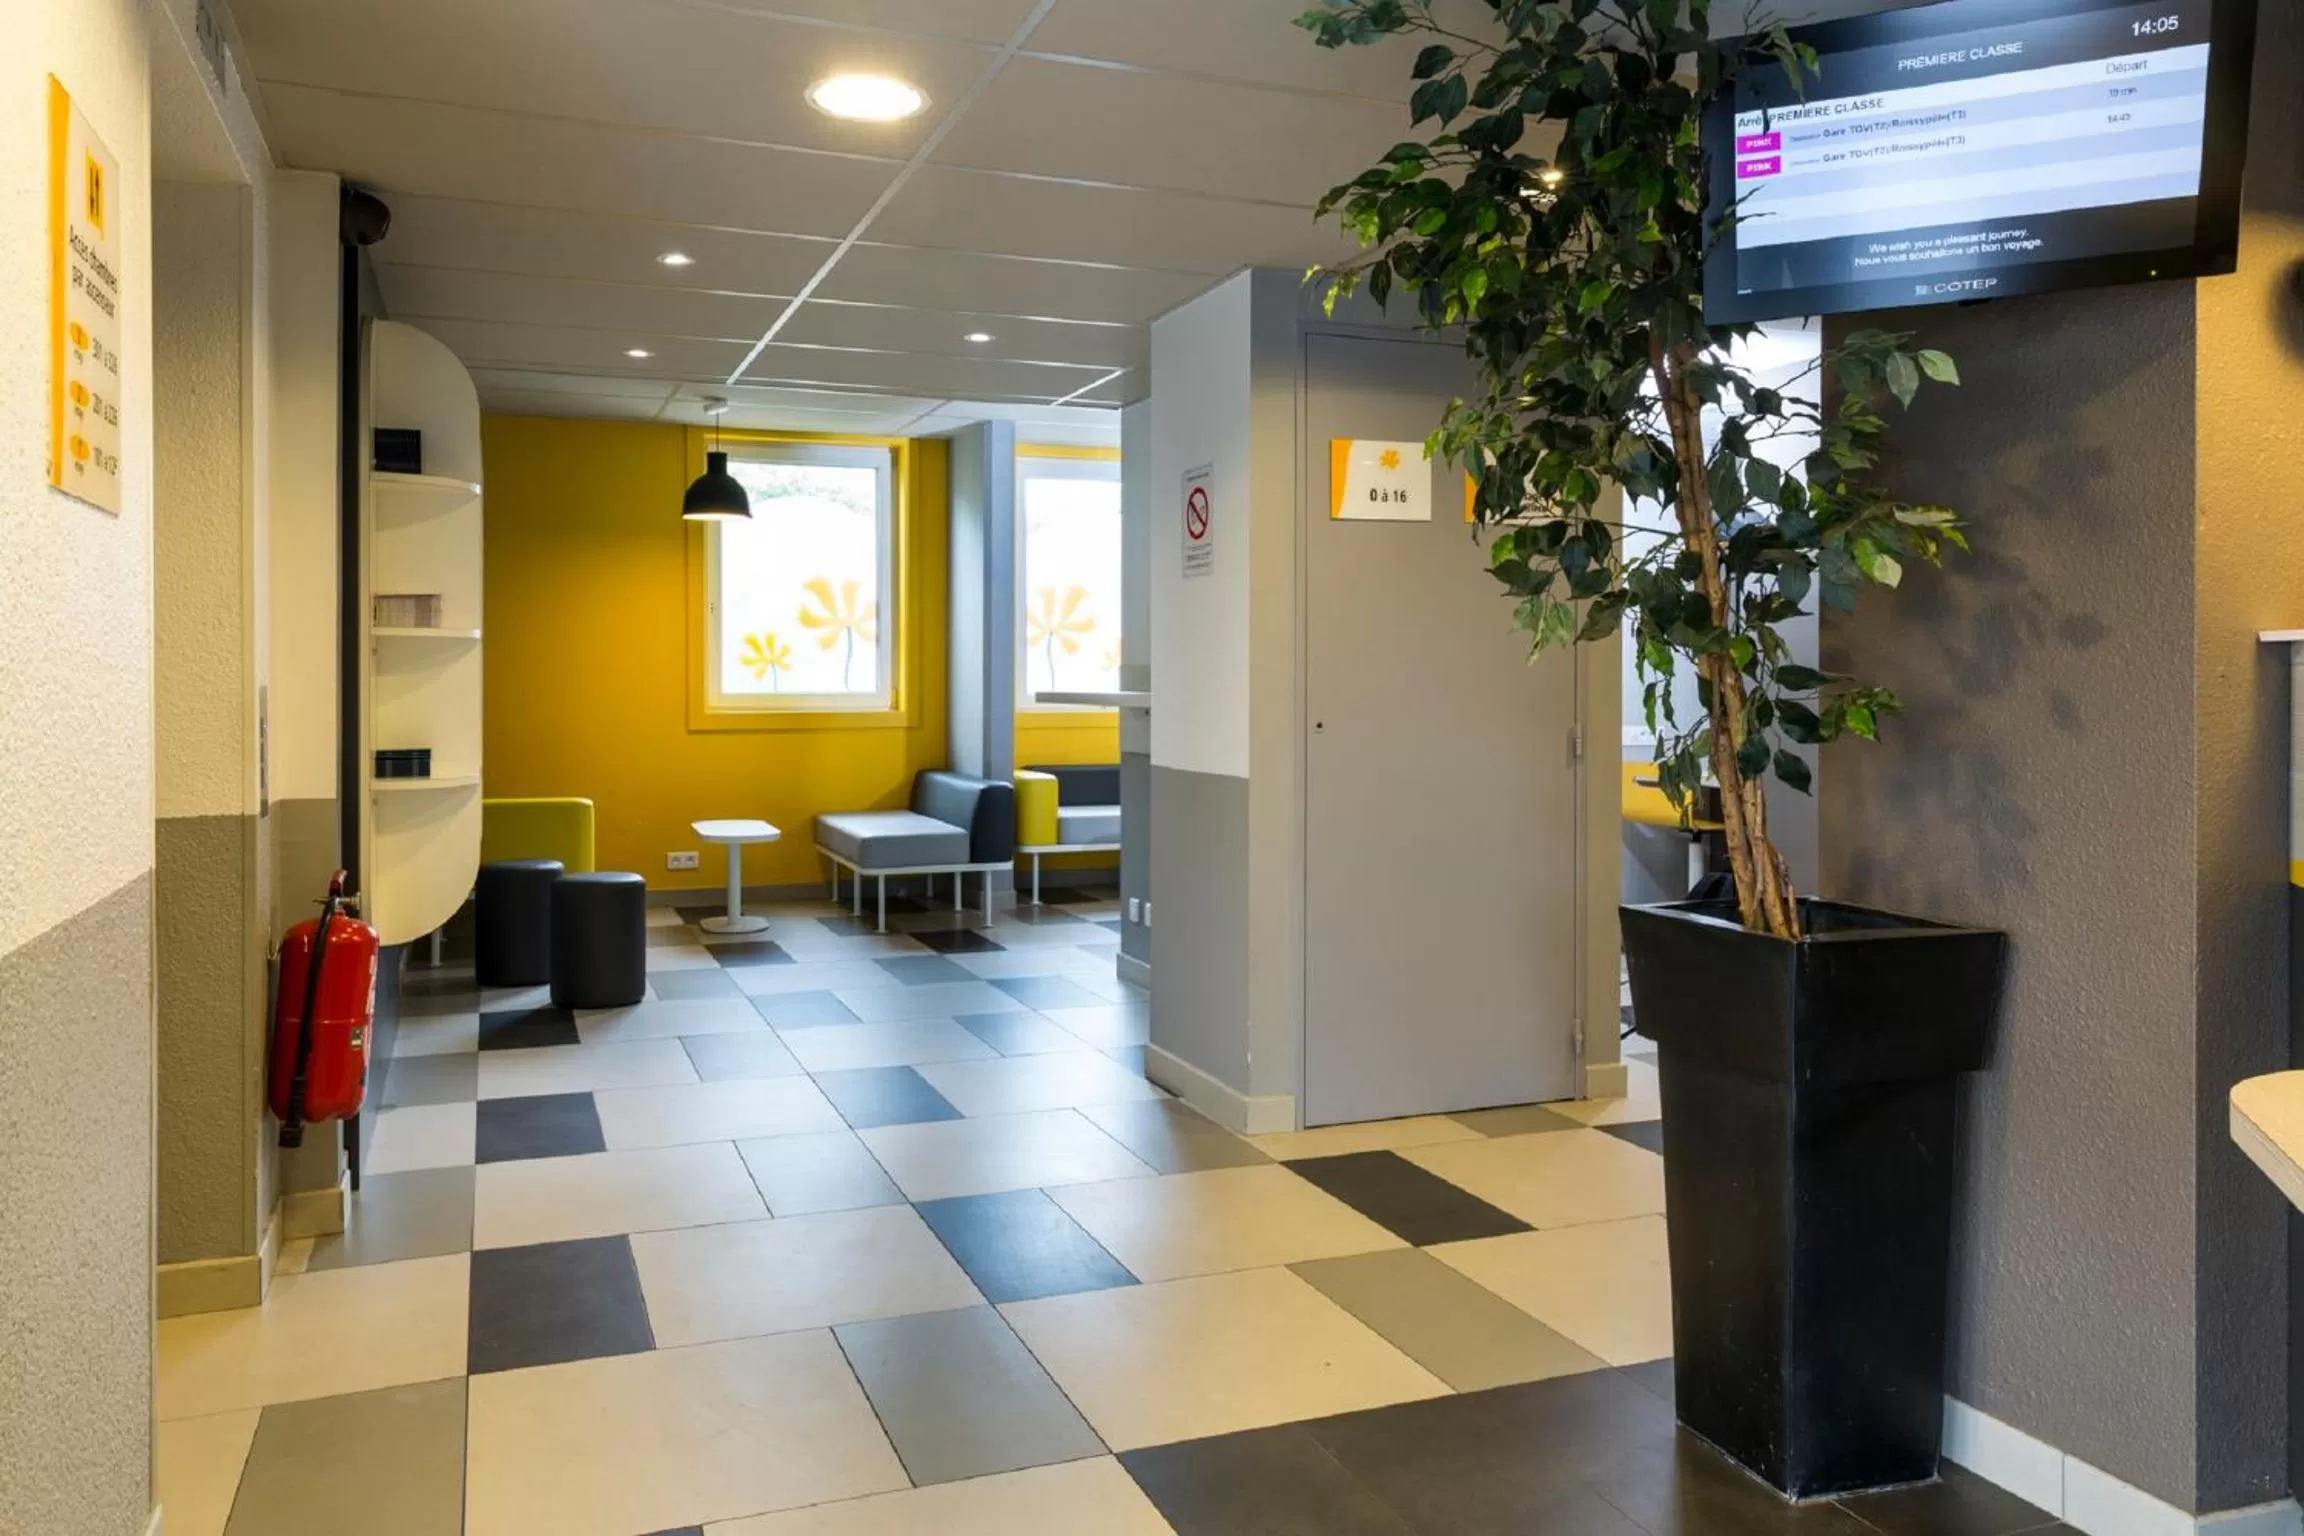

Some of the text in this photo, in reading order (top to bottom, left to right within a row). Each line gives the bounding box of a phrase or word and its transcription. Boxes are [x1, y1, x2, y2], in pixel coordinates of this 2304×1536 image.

[2132, 15, 2179, 37] 14:05
[1898, 41, 2023, 71] PREMIERE CLASSE
[1834, 98, 1884, 114] CLASSE
[1854, 257, 1881, 267] Nous
[1882, 253, 1907, 264] vous
[1965, 246, 1979, 254] un
[1981, 243, 2001, 253] bon
[2004, 238, 2044, 251] voyage.
[1868, 244, 1887, 254] We
[1914, 239, 1933, 251] you
[1943, 232, 1986, 247] pleasant
[1988, 228, 2029, 242] journey.
[1370, 487, 1407, 503] 0 à 16
